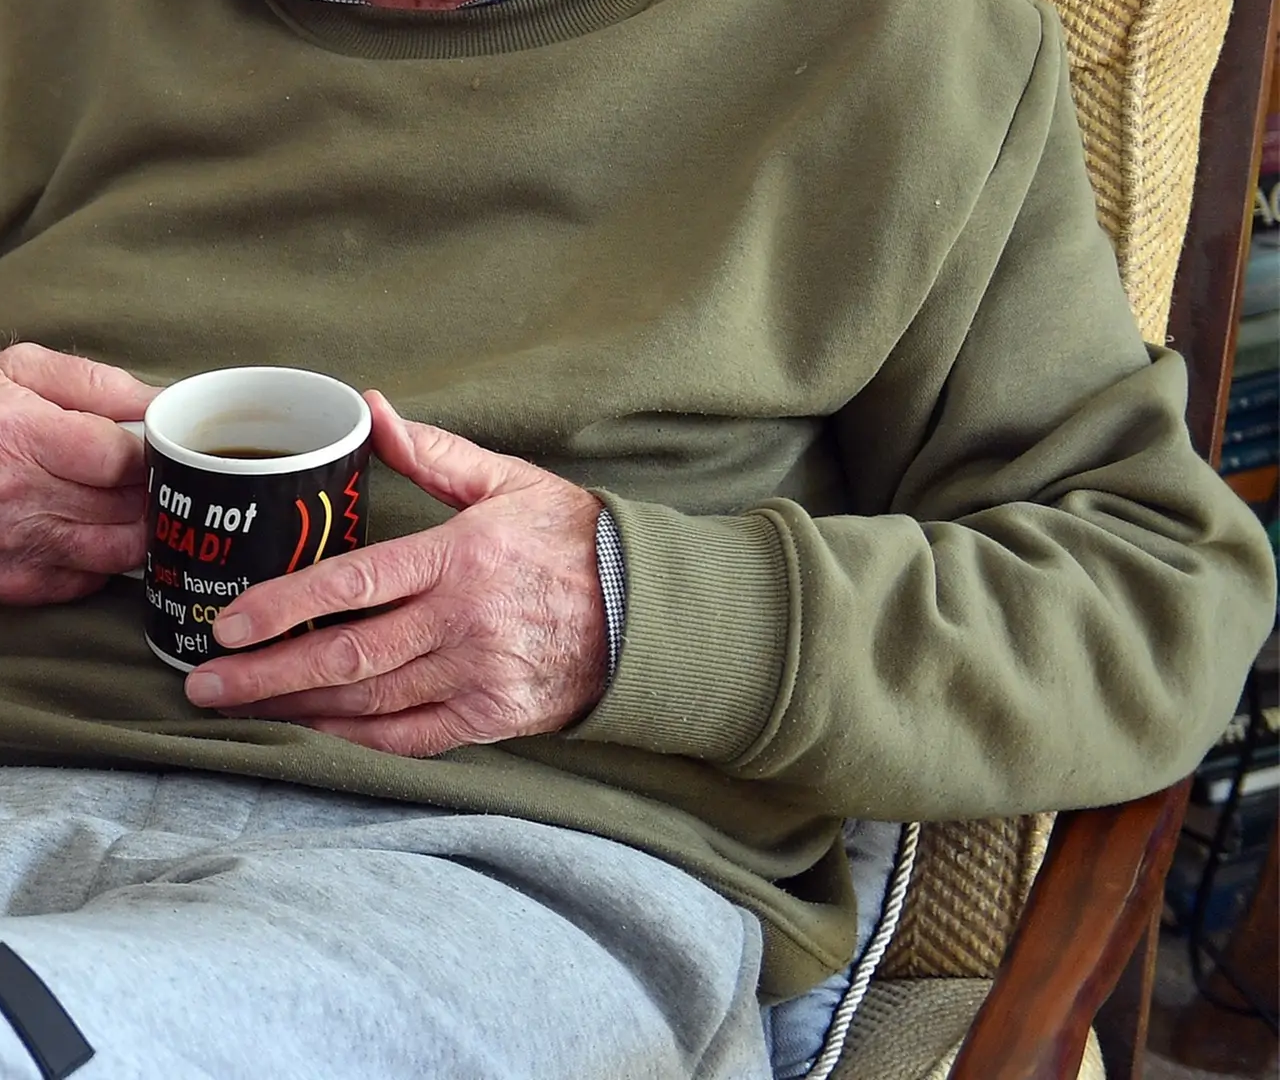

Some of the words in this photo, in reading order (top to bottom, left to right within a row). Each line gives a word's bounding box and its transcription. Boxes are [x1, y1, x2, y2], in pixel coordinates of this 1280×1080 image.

[147, 466, 155, 494] I
[158, 482, 193, 519] am
[204, 500, 258, 534] not
[154, 511, 233, 566] DEAD!
[154, 560, 180, 588] just
[183, 570, 250, 597] haven't
[165, 597, 187, 626] my
[174, 629, 209, 655] yet!
